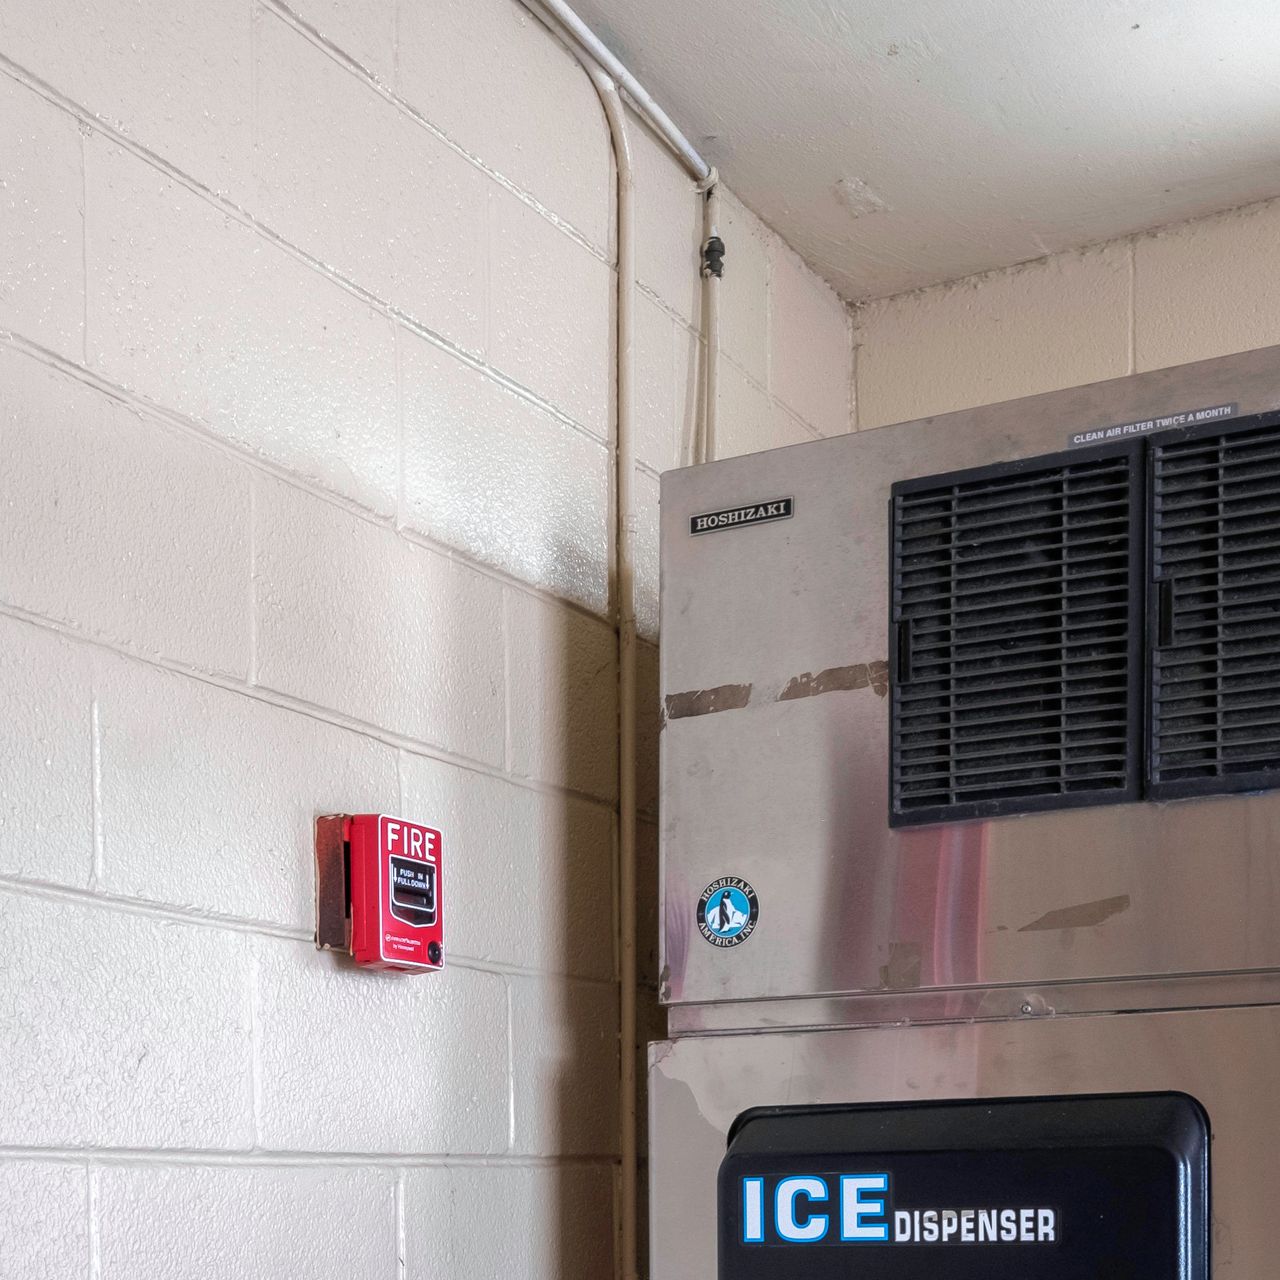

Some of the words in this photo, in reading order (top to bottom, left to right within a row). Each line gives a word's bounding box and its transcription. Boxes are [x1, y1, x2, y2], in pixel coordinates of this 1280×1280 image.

[1073, 431, 1104, 444] CLEAN
[1106, 427, 1122, 438] AIR
[1123, 421, 1154, 435] FILTER
[1155, 414, 1185, 428] TWICE
[1187, 414, 1195, 422] A
[1196, 405, 1232, 420] MONTH
[696, 502, 786, 530] HOSHIZAKI
[387, 822, 436, 862] FIRE
[400, 869, 414, 878] PUSH
[701, 878, 755, 901] HOSHIZAKI
[743, 1174, 889, 1243] ICE
[894, 1209, 1055, 1243] DISPENSER
